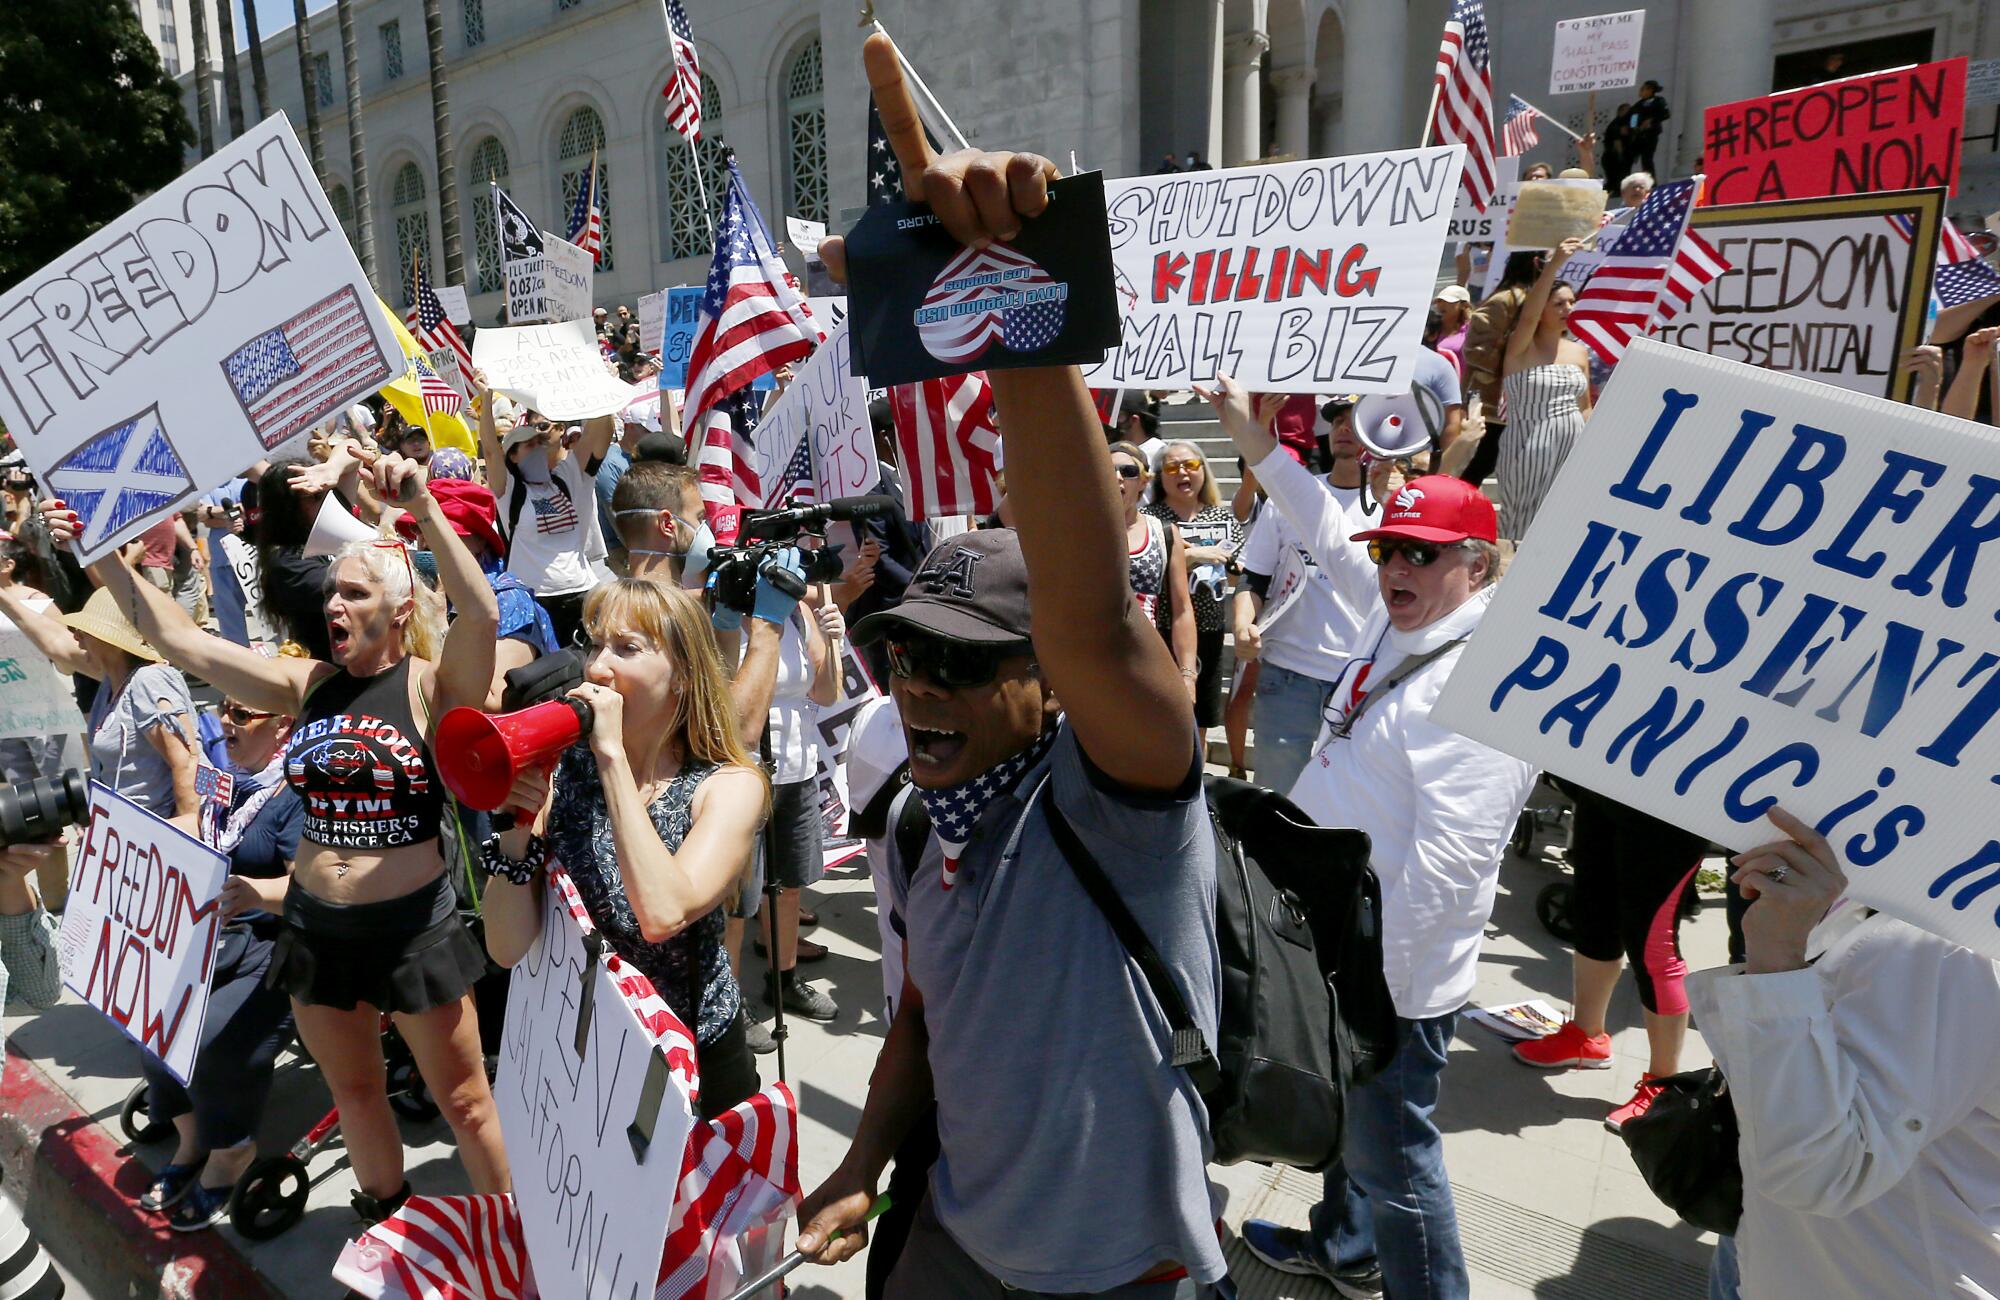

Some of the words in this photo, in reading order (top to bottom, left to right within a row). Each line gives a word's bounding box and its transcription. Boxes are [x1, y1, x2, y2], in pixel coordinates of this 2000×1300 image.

[1584, 17, 1613, 28] SENT
[1617, 14, 1633, 23] ME
[1554, 60, 1635, 81] CONSTITUTION
[1559, 82, 1595, 92] TRUMP
[1600, 78, 1629, 88] 2020
[1708, 68, 1947, 161] #REOPEN
[1711, 160, 1788, 206] CA
[1829, 128, 1957, 196] NOW
[1107, 151, 1454, 250] SHUTDOWN
[1447, 220, 1493, 236] RUS
[0, 136, 330, 436] FREEDOM
[546, 259, 588, 293] FREEDOM
[1151, 243, 1382, 306] KILLING
[1685, 232, 1898, 314] EEDOM
[511, 297, 535, 318] OPEN
[914, 305, 949, 327] USA
[494, 353, 540, 374] JOBS
[550, 346, 584, 366] ARE
[517, 329, 562, 351] ALL
[818, 331, 851, 406] UP
[1083, 310, 1243, 382] MALL
[1268, 306, 1409, 383] BIZ
[1708, 321, 1888, 376] ESSENTIAL
[815, 396, 853, 458] OUR
[1609, 387, 2000, 621] LIBER
[1538, 520, 2000, 783] ESSENT
[286, 714, 429, 795] WERHOUSE
[1489, 635, 1820, 824] PANIC
[1813, 766, 1926, 867] is
[307, 791, 397, 820] GYM
[333, 815, 419, 834] FISHER'S
[387, 830, 413, 845] CA
[76, 803, 220, 985] FREEDOM
[85, 915, 193, 1061] NOW
